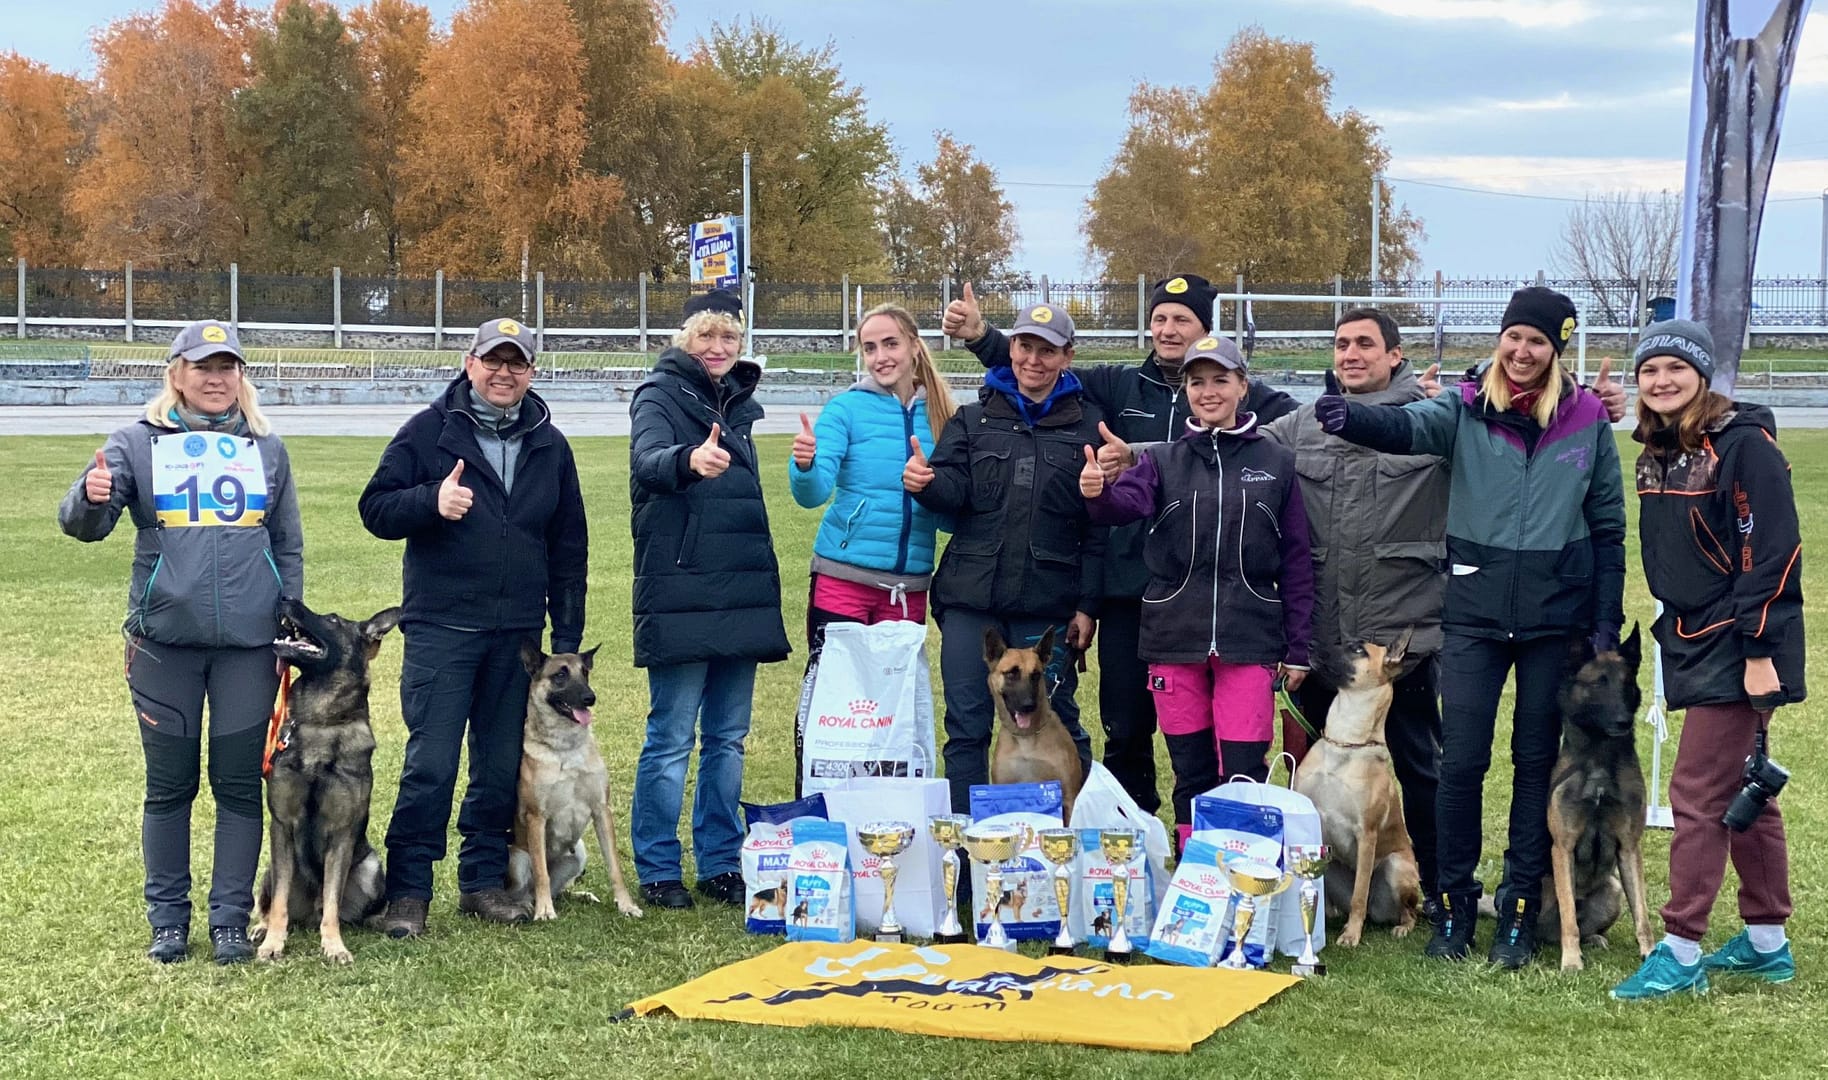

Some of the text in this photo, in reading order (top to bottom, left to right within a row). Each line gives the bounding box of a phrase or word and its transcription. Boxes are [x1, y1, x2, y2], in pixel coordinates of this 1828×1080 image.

[175, 474, 246, 523] 19
[818, 714, 893, 728] ROYAL CANIN
[763, 857, 788, 867] MAX
[794, 860, 839, 869] ROYAL CANIN
[1089, 867, 1112, 876] ROYAL
[1178, 879, 1203, 892] ROYAL
